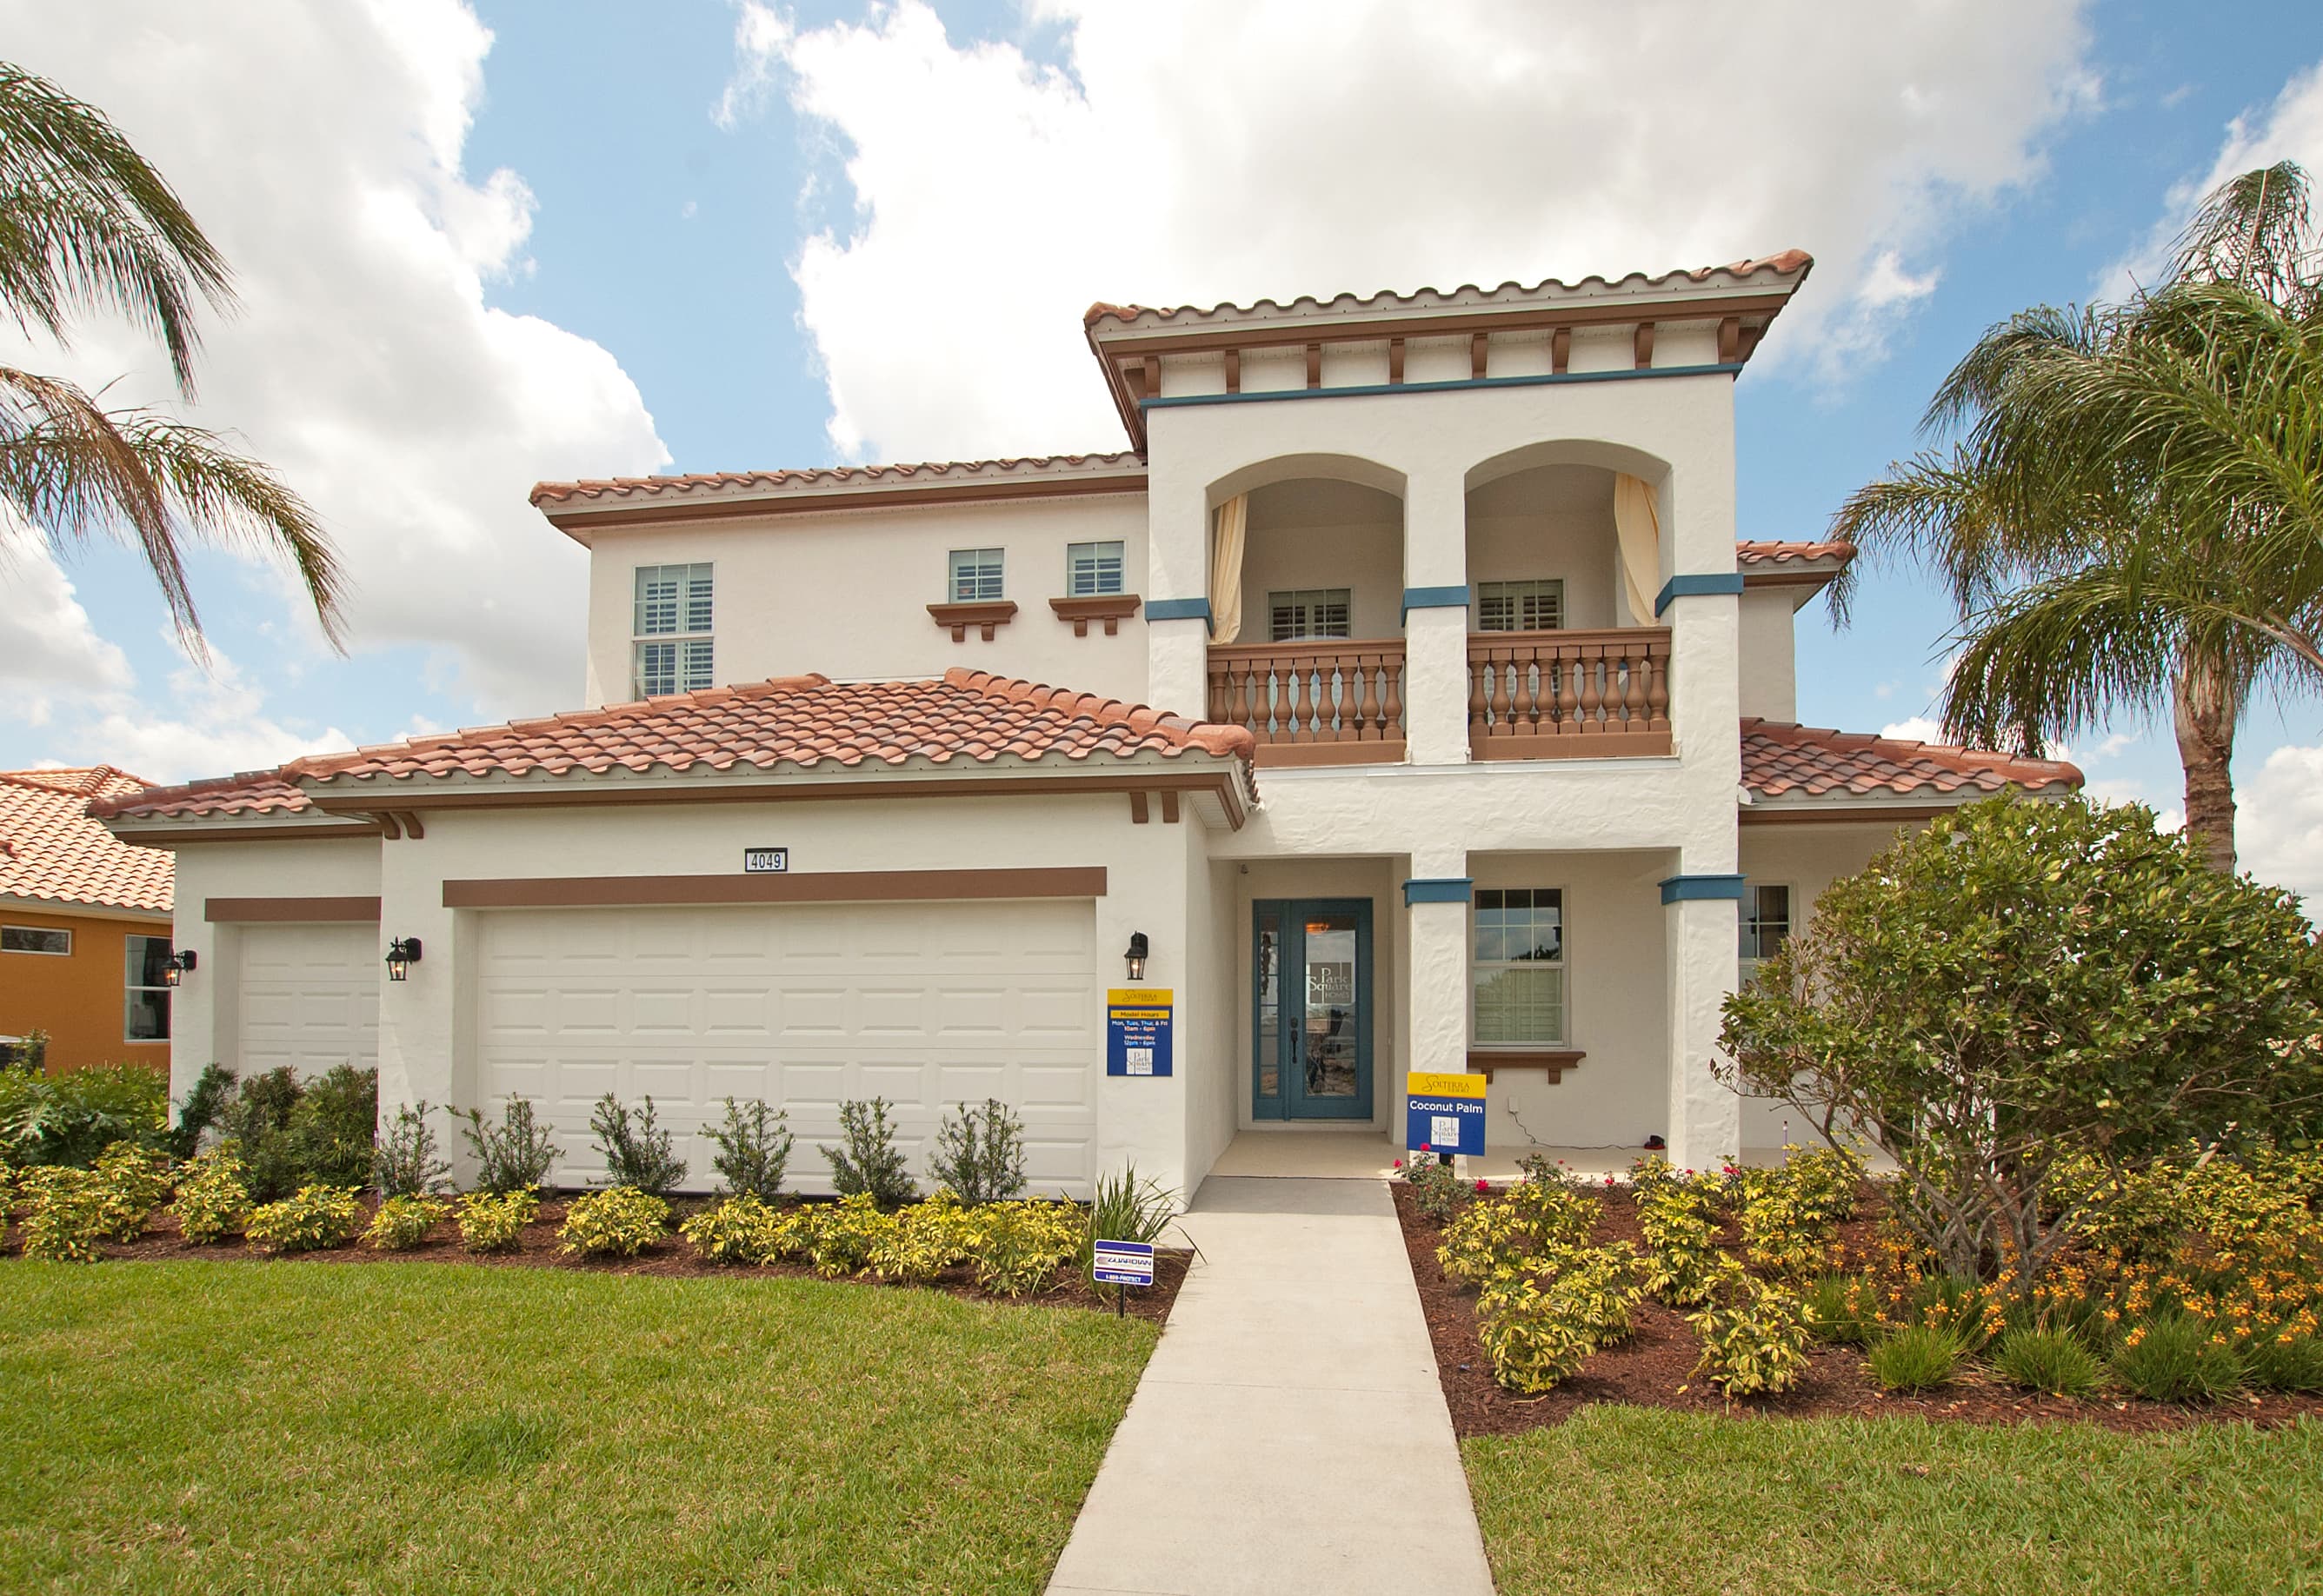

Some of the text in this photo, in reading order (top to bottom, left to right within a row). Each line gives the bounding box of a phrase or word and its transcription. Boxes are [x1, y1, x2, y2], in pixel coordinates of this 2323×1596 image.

[751, 853, 781, 868] 4049
[1321, 965, 1348, 983] Park
[1309, 976, 1351, 994] Square
[1421, 1074, 1471, 1093] SOLTERRA
[1409, 1100, 1483, 1114] Coconut Palm
